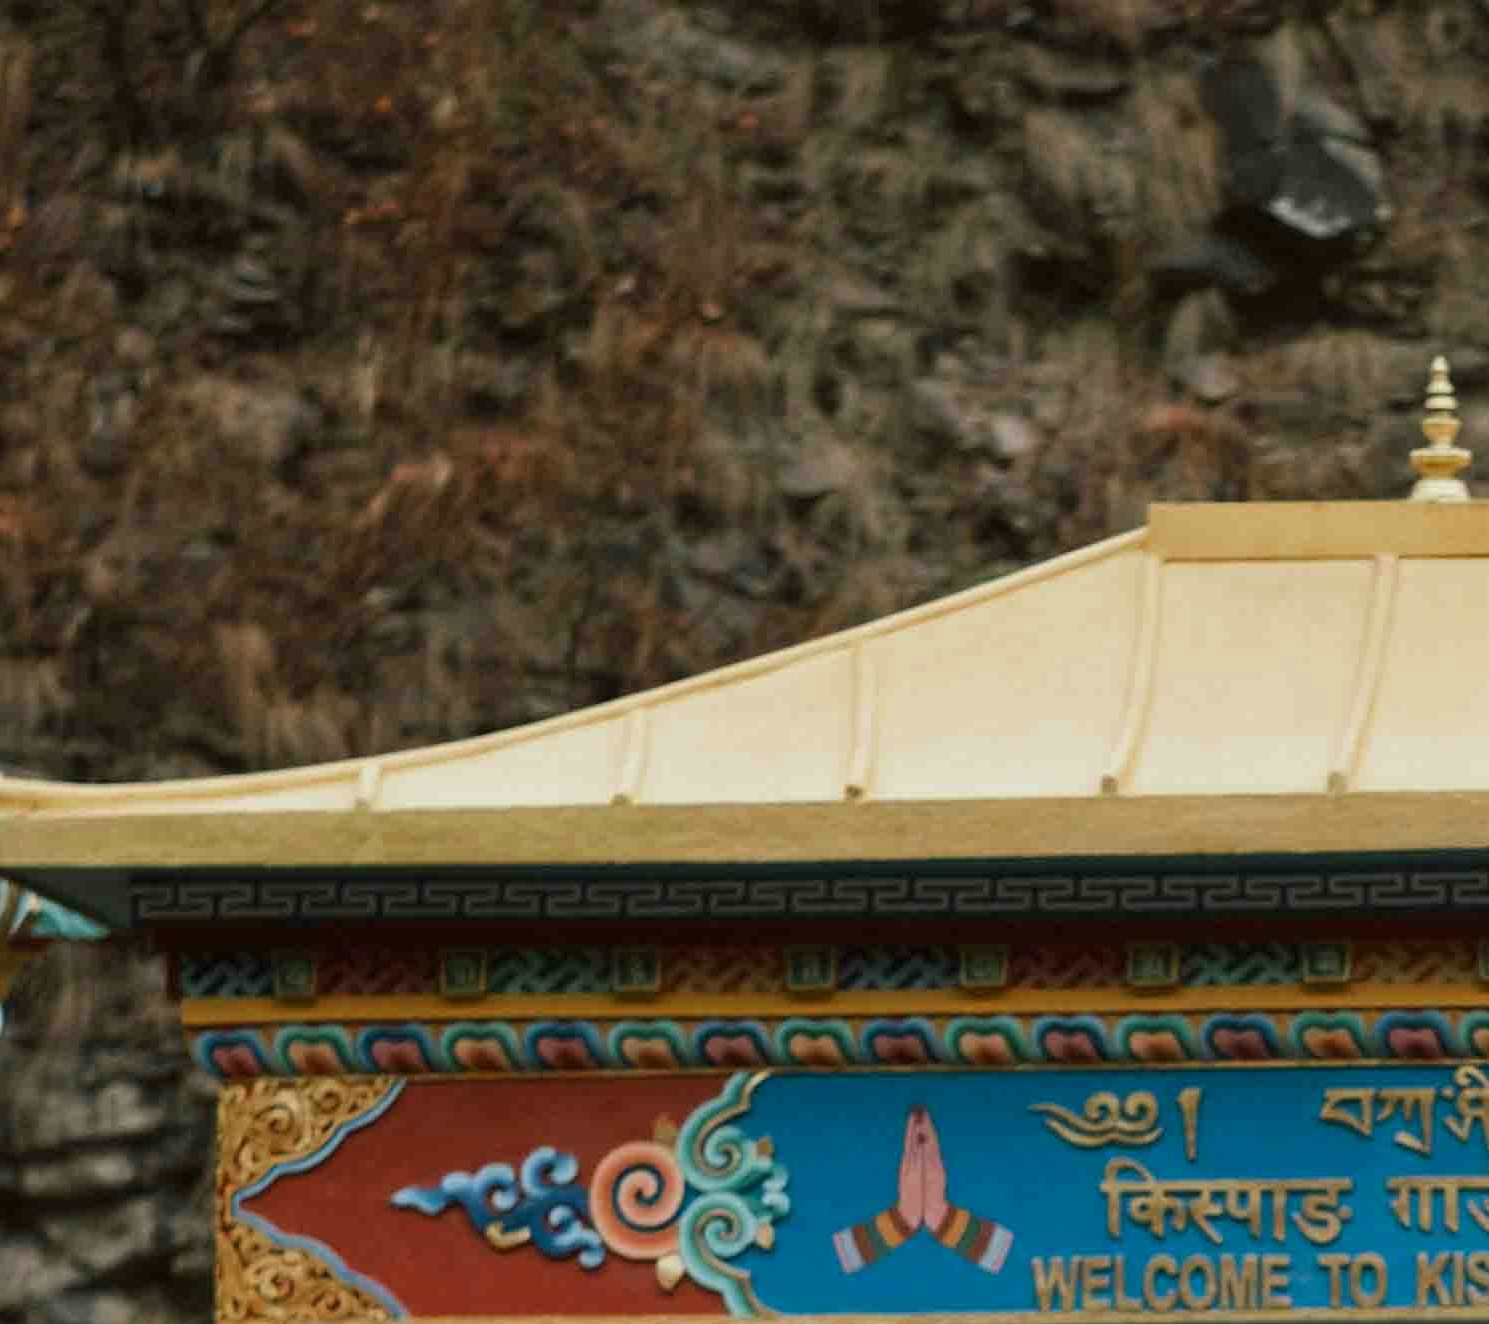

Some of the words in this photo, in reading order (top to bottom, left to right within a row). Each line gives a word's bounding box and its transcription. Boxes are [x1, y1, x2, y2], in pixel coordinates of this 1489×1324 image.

[1099, 1158, 1353, 1244] किस्पाङ
[1032, 1253, 1294, 1311] WELCOME
[1318, 1254, 1389, 1308] TO
